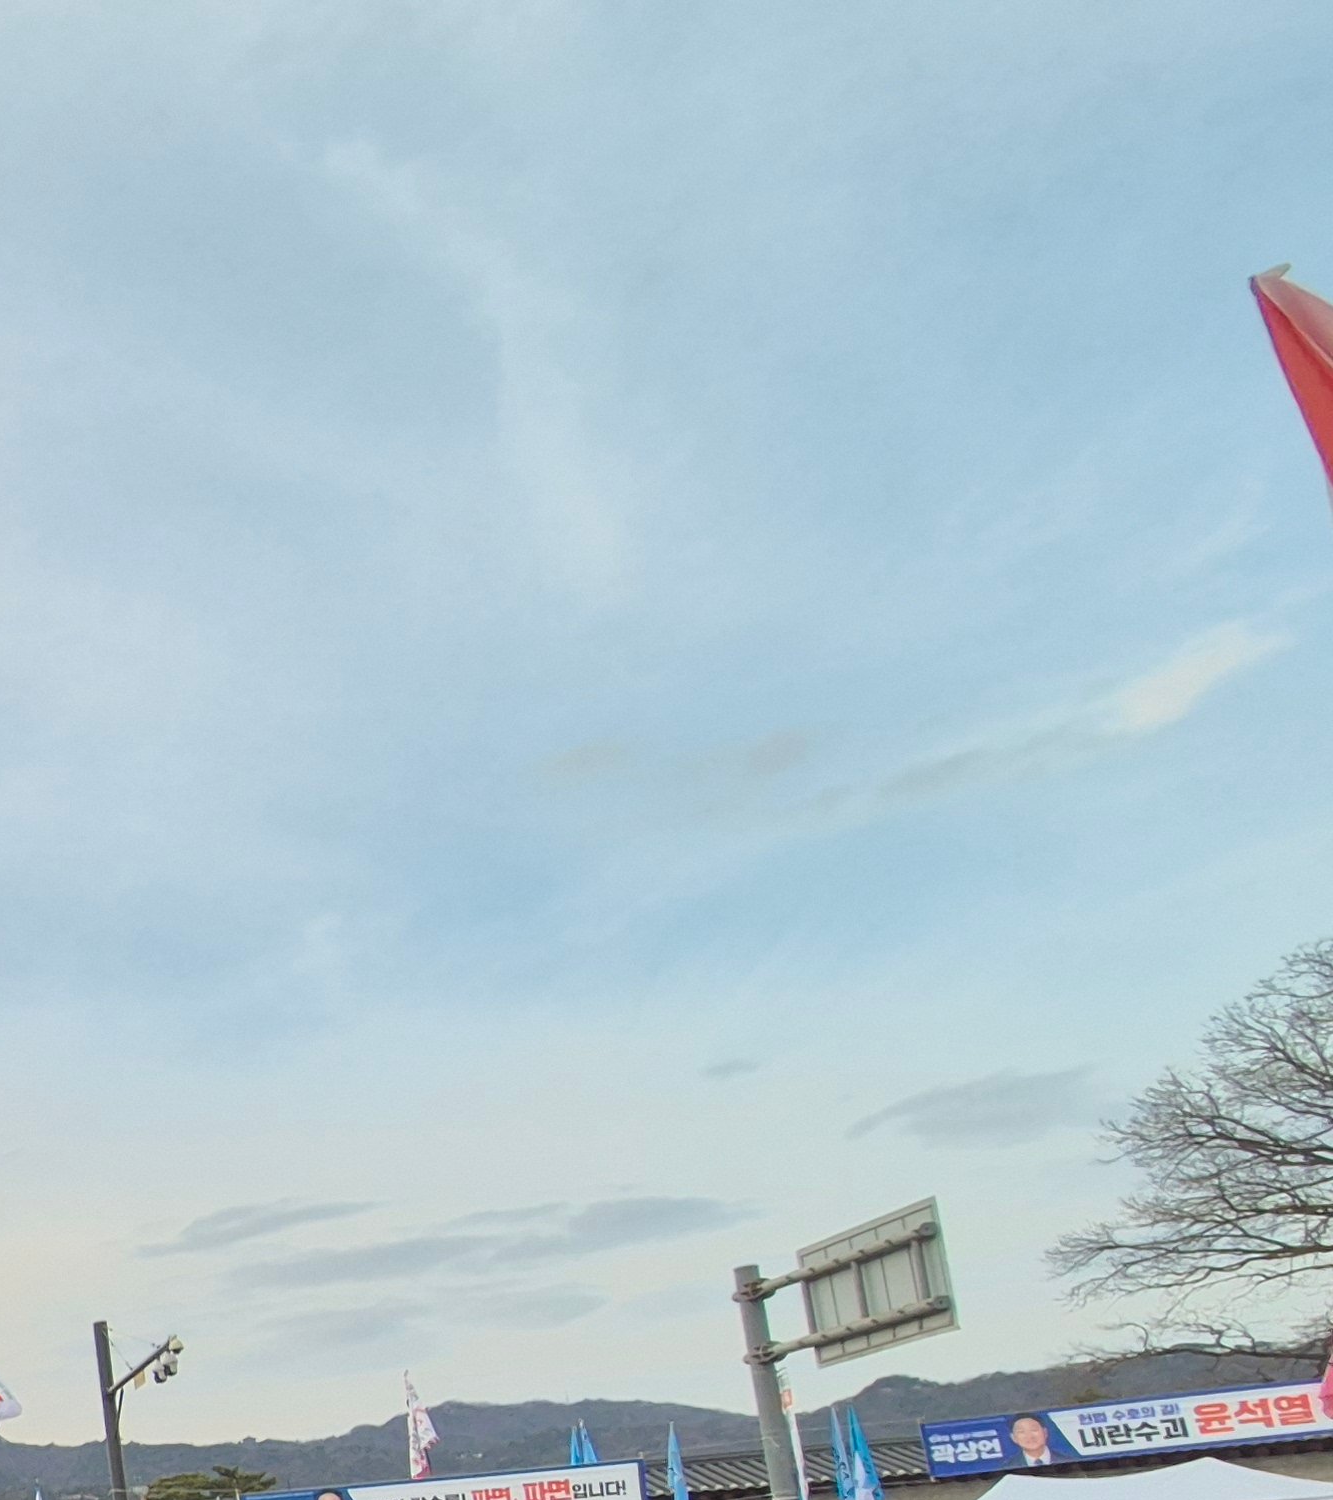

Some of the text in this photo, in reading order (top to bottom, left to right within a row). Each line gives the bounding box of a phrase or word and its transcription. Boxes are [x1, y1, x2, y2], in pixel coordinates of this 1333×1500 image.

[1078, 1393, 1317, 1449] 내란수괴 윤석열
[929, 1438, 1004, 1464] 곽상언
